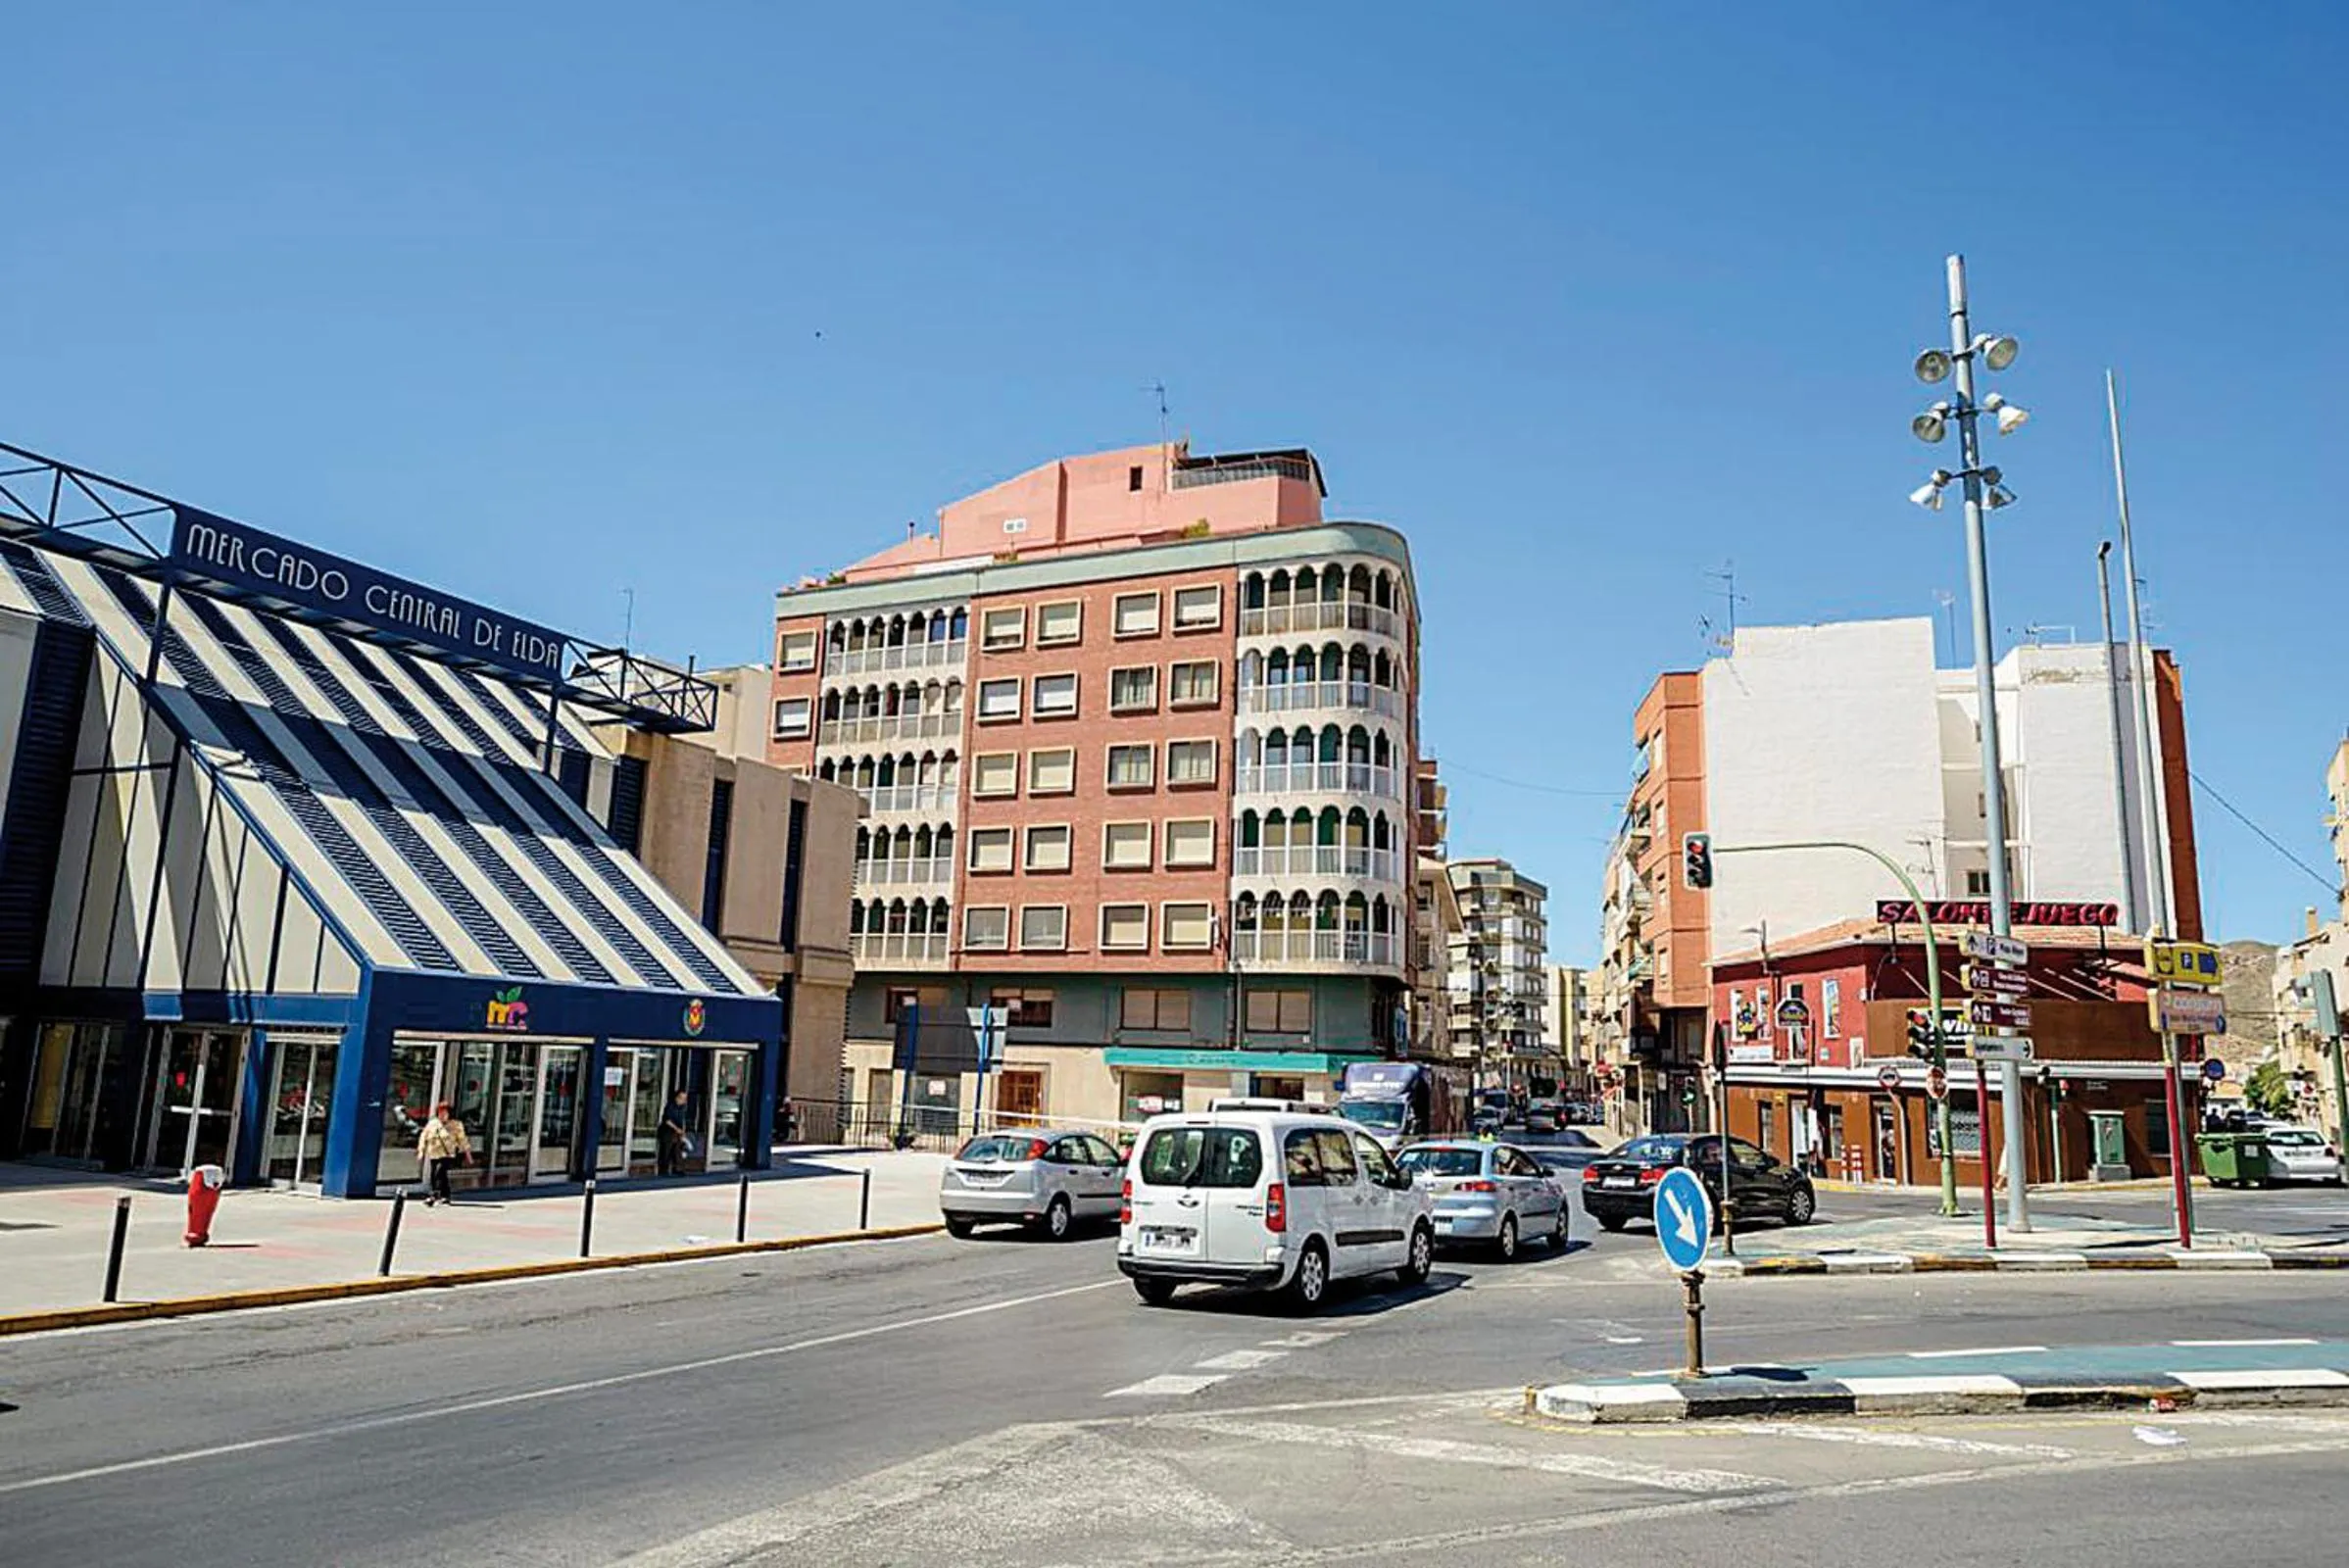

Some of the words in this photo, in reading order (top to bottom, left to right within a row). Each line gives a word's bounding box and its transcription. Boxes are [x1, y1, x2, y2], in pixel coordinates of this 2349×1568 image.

[187, 523, 349, 600] MERCADO
[366, 586, 461, 639] CENTRAL
[474, 618, 503, 652] DE
[512, 632, 559, 669] ELDA
[2021, 903, 2119, 924] JUEGO
